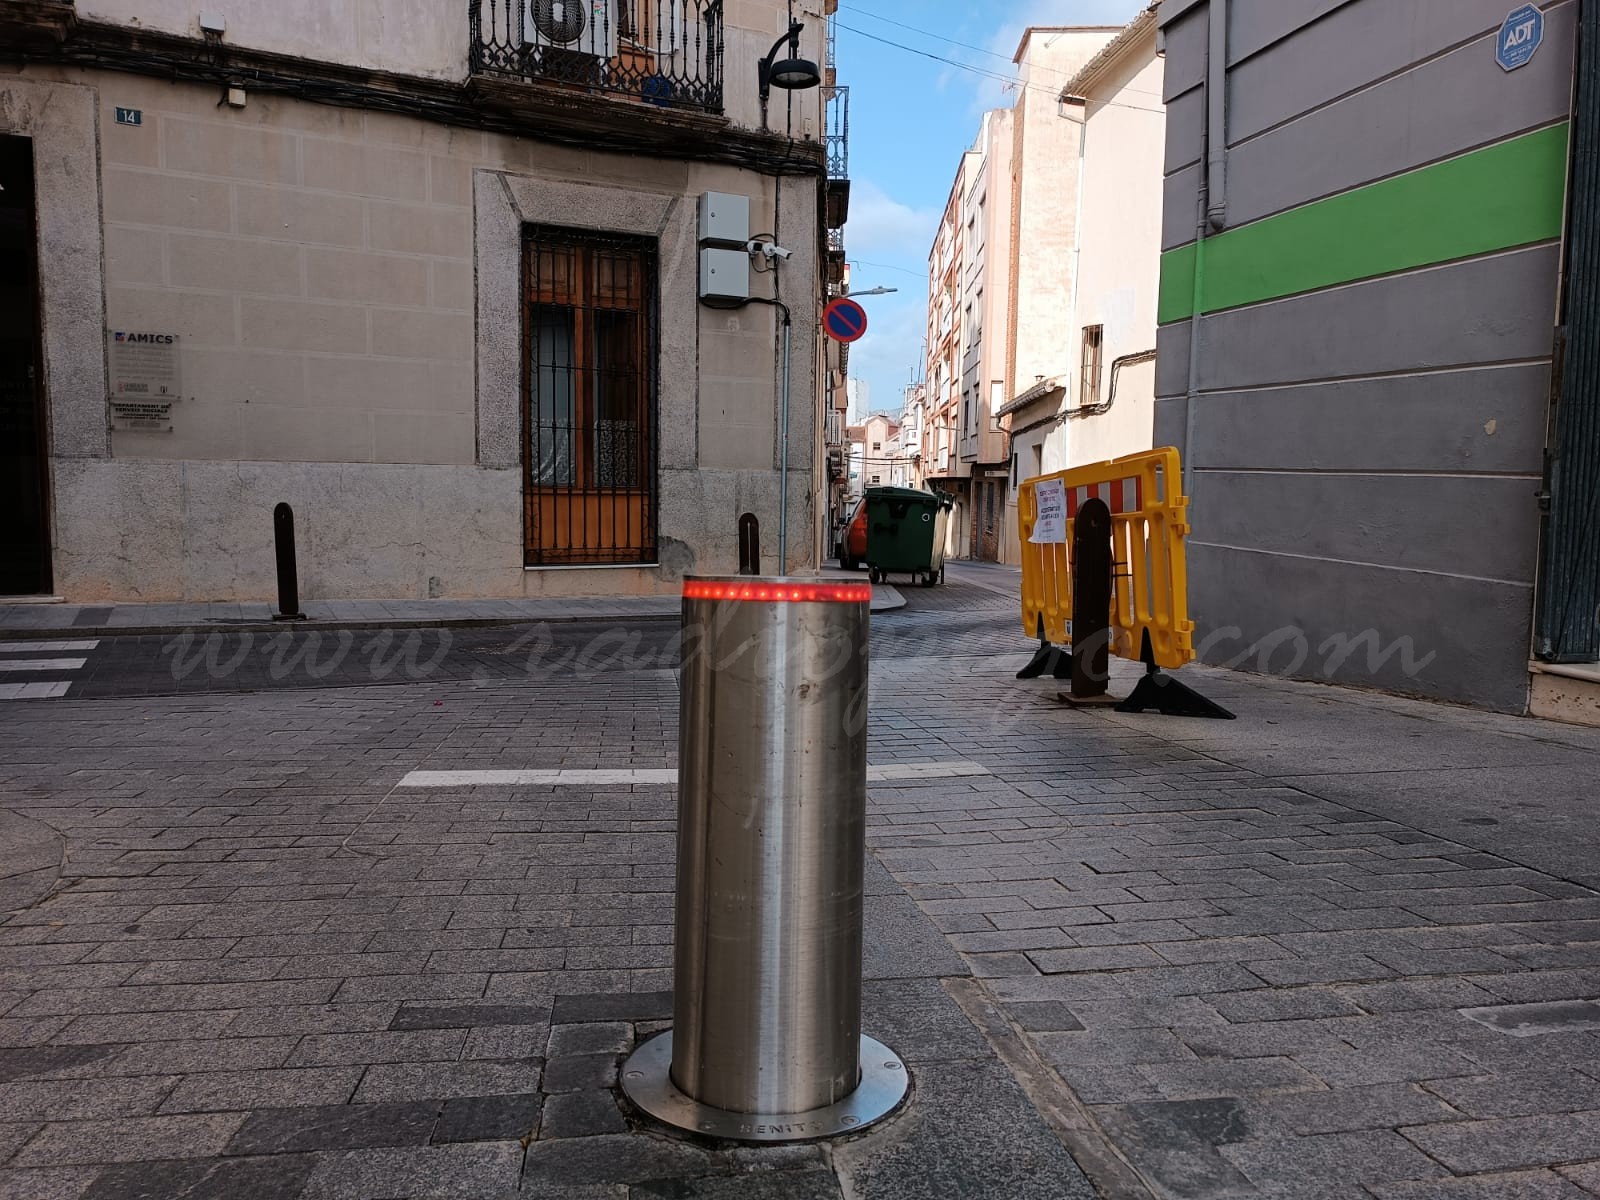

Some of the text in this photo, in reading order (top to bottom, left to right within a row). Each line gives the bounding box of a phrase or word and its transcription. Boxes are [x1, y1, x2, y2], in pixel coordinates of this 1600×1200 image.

[1504, 19, 1535, 51] ADT
[122, 109, 136, 123] 14
[127, 332, 173, 344] AMICS
